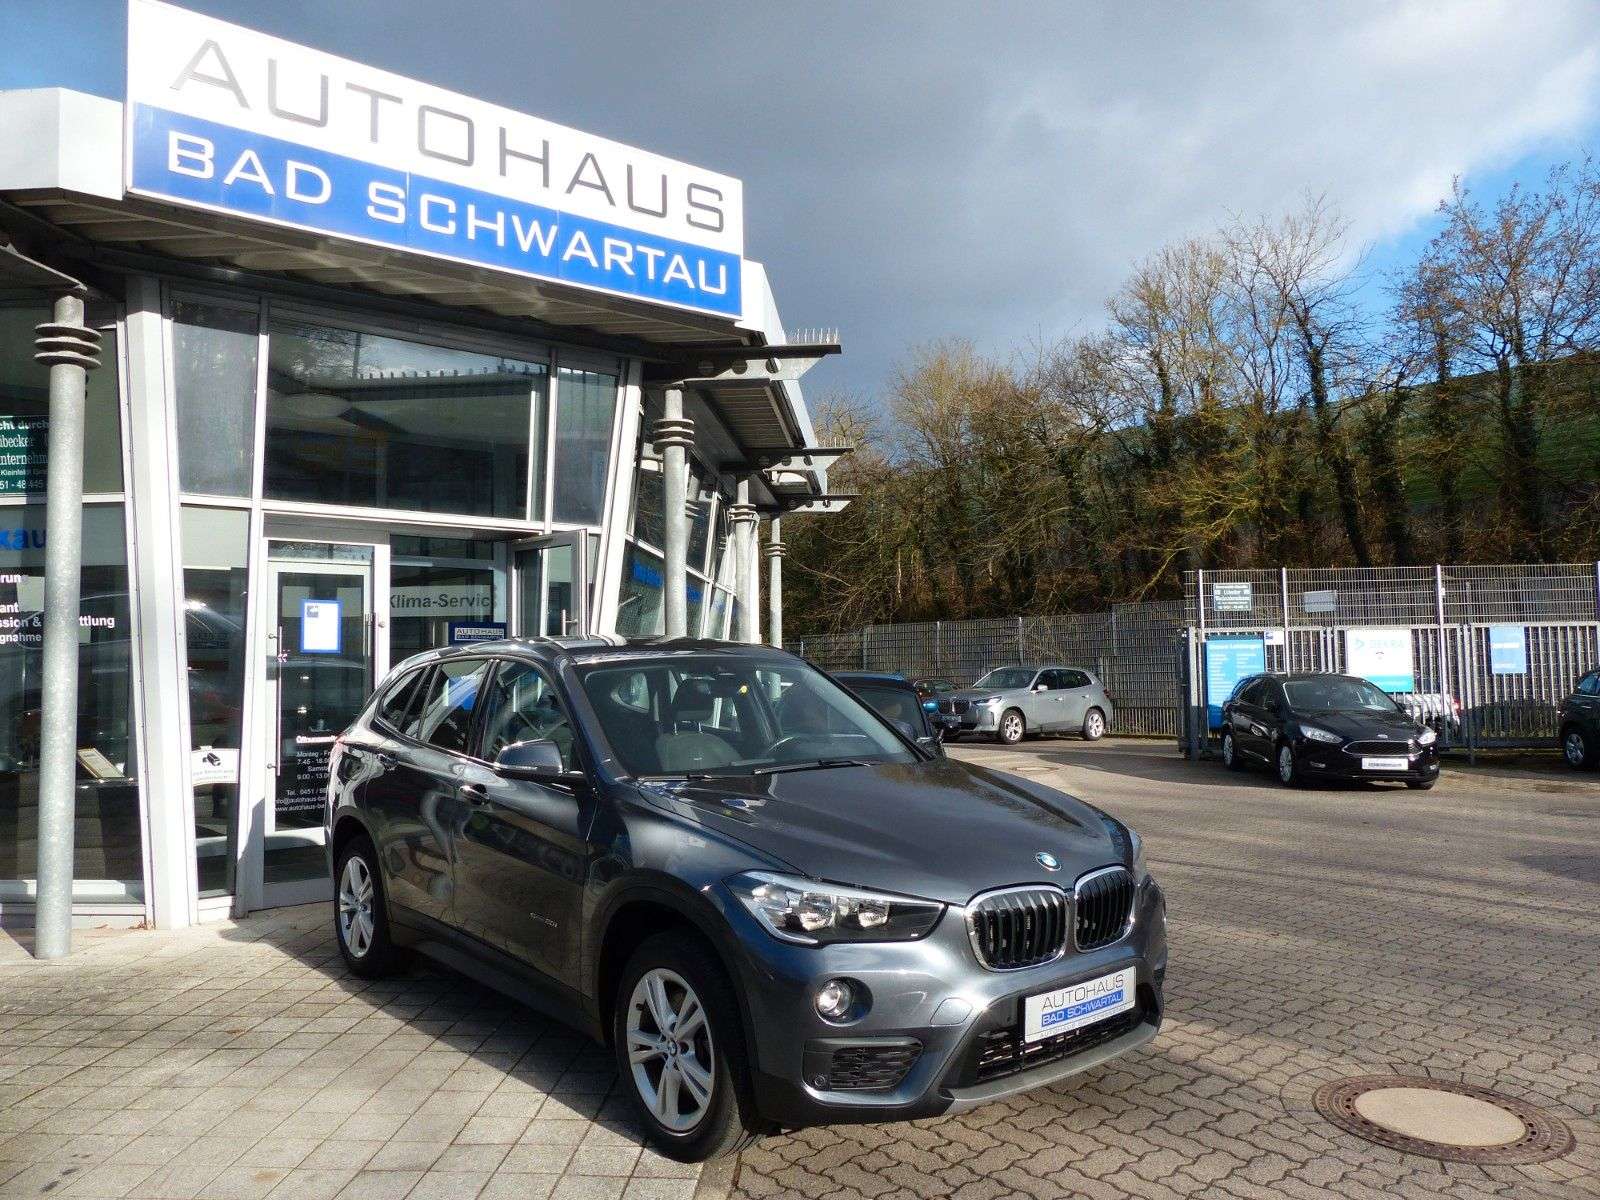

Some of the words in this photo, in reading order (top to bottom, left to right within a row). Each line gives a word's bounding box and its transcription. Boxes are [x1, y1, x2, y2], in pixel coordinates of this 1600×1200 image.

[169, 37, 724, 233] AUTOHAUS
[168, 130, 333, 205] BAD
[366, 180, 727, 296] SCHWARTAU
[1042, 973, 1124, 1011] AUTOHAUS
[1043, 1010, 1065, 1026] BAD
[1067, 991, 1124, 1019] SCHWARTAU
